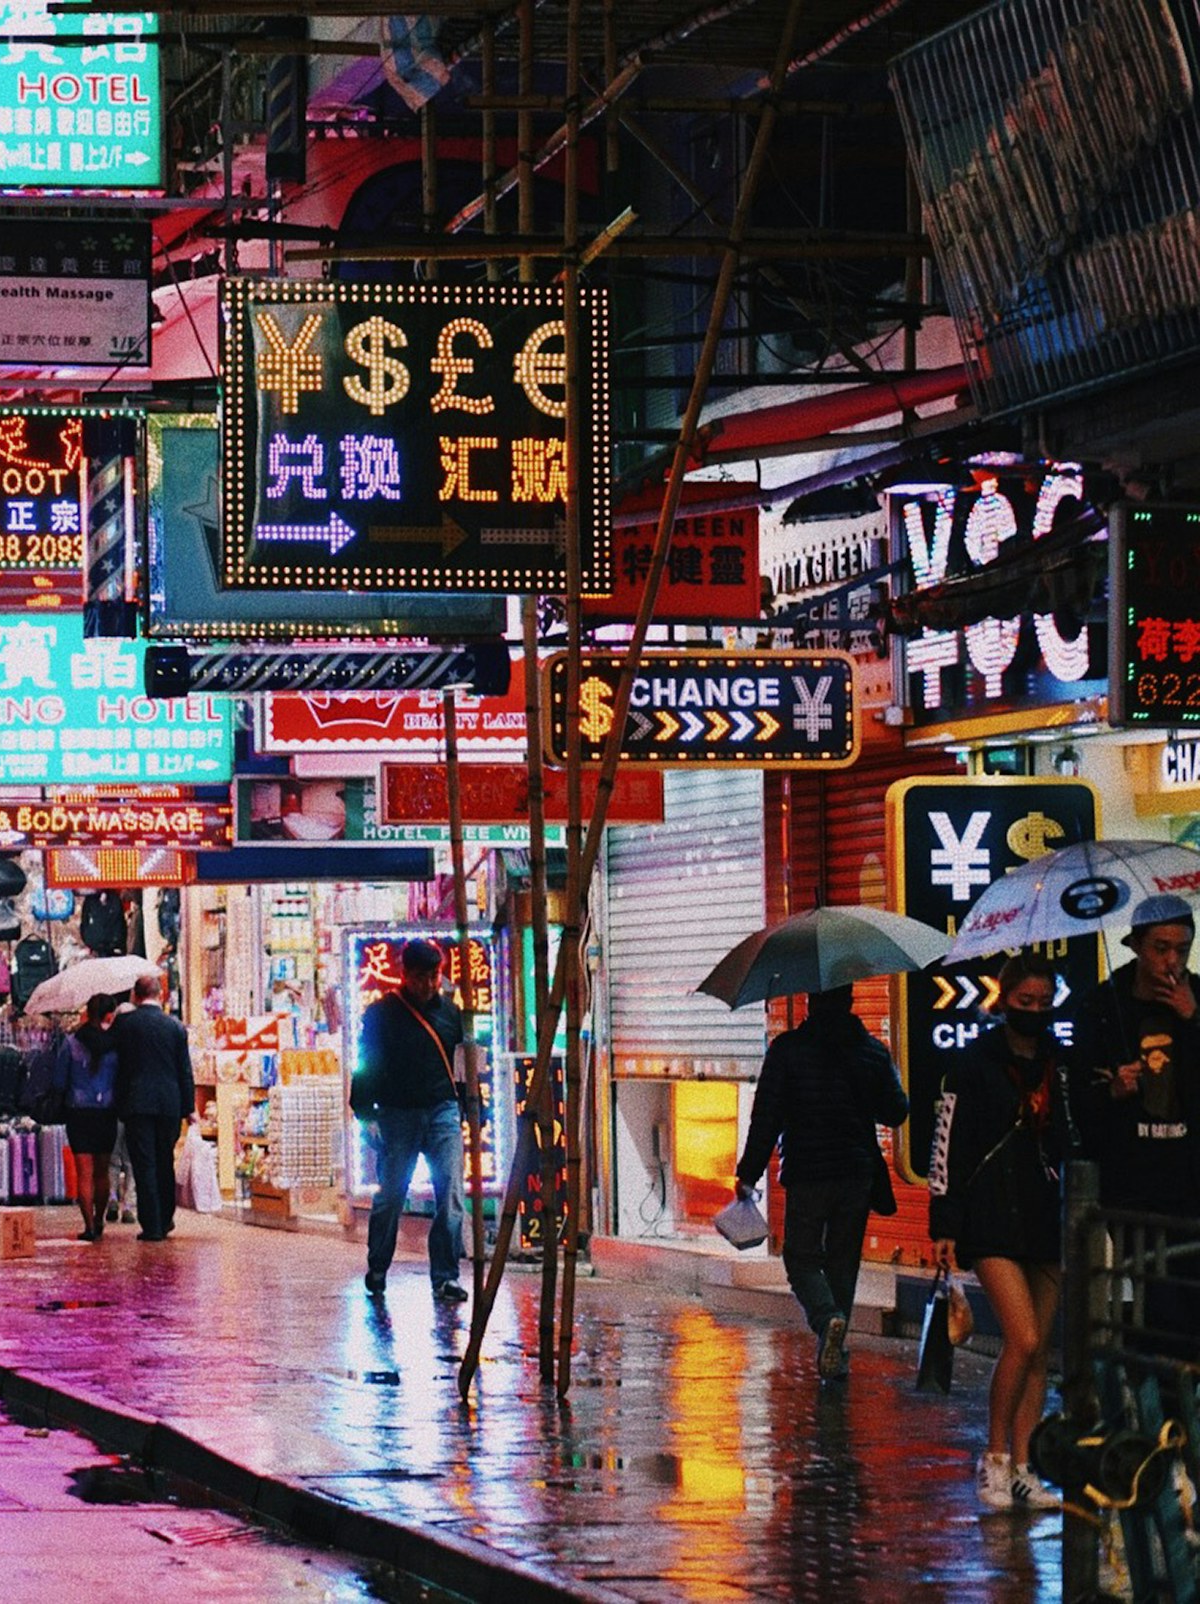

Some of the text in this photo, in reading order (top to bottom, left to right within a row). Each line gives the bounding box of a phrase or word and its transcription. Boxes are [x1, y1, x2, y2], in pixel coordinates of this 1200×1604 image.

[16, 71, 152, 105] HOTEL
[46, 287, 114, 302] Massage
[342, 315, 411, 416] $
[429, 317, 495, 414] £
[512, 319, 567, 418] €
[6, 501, 79, 533] 正宗
[630, 678, 780, 707] CHANGE
[97, 696, 224, 724] HOTEL
[403, 712, 479, 730] BEATY
[17, 808, 83, 832] BODY
[87, 808, 204, 833] MASSAGE
[363, 826, 427, 840] HOTEL
[440, 826, 490, 840] FEE
[932, 1021, 1074, 1049] CHE
